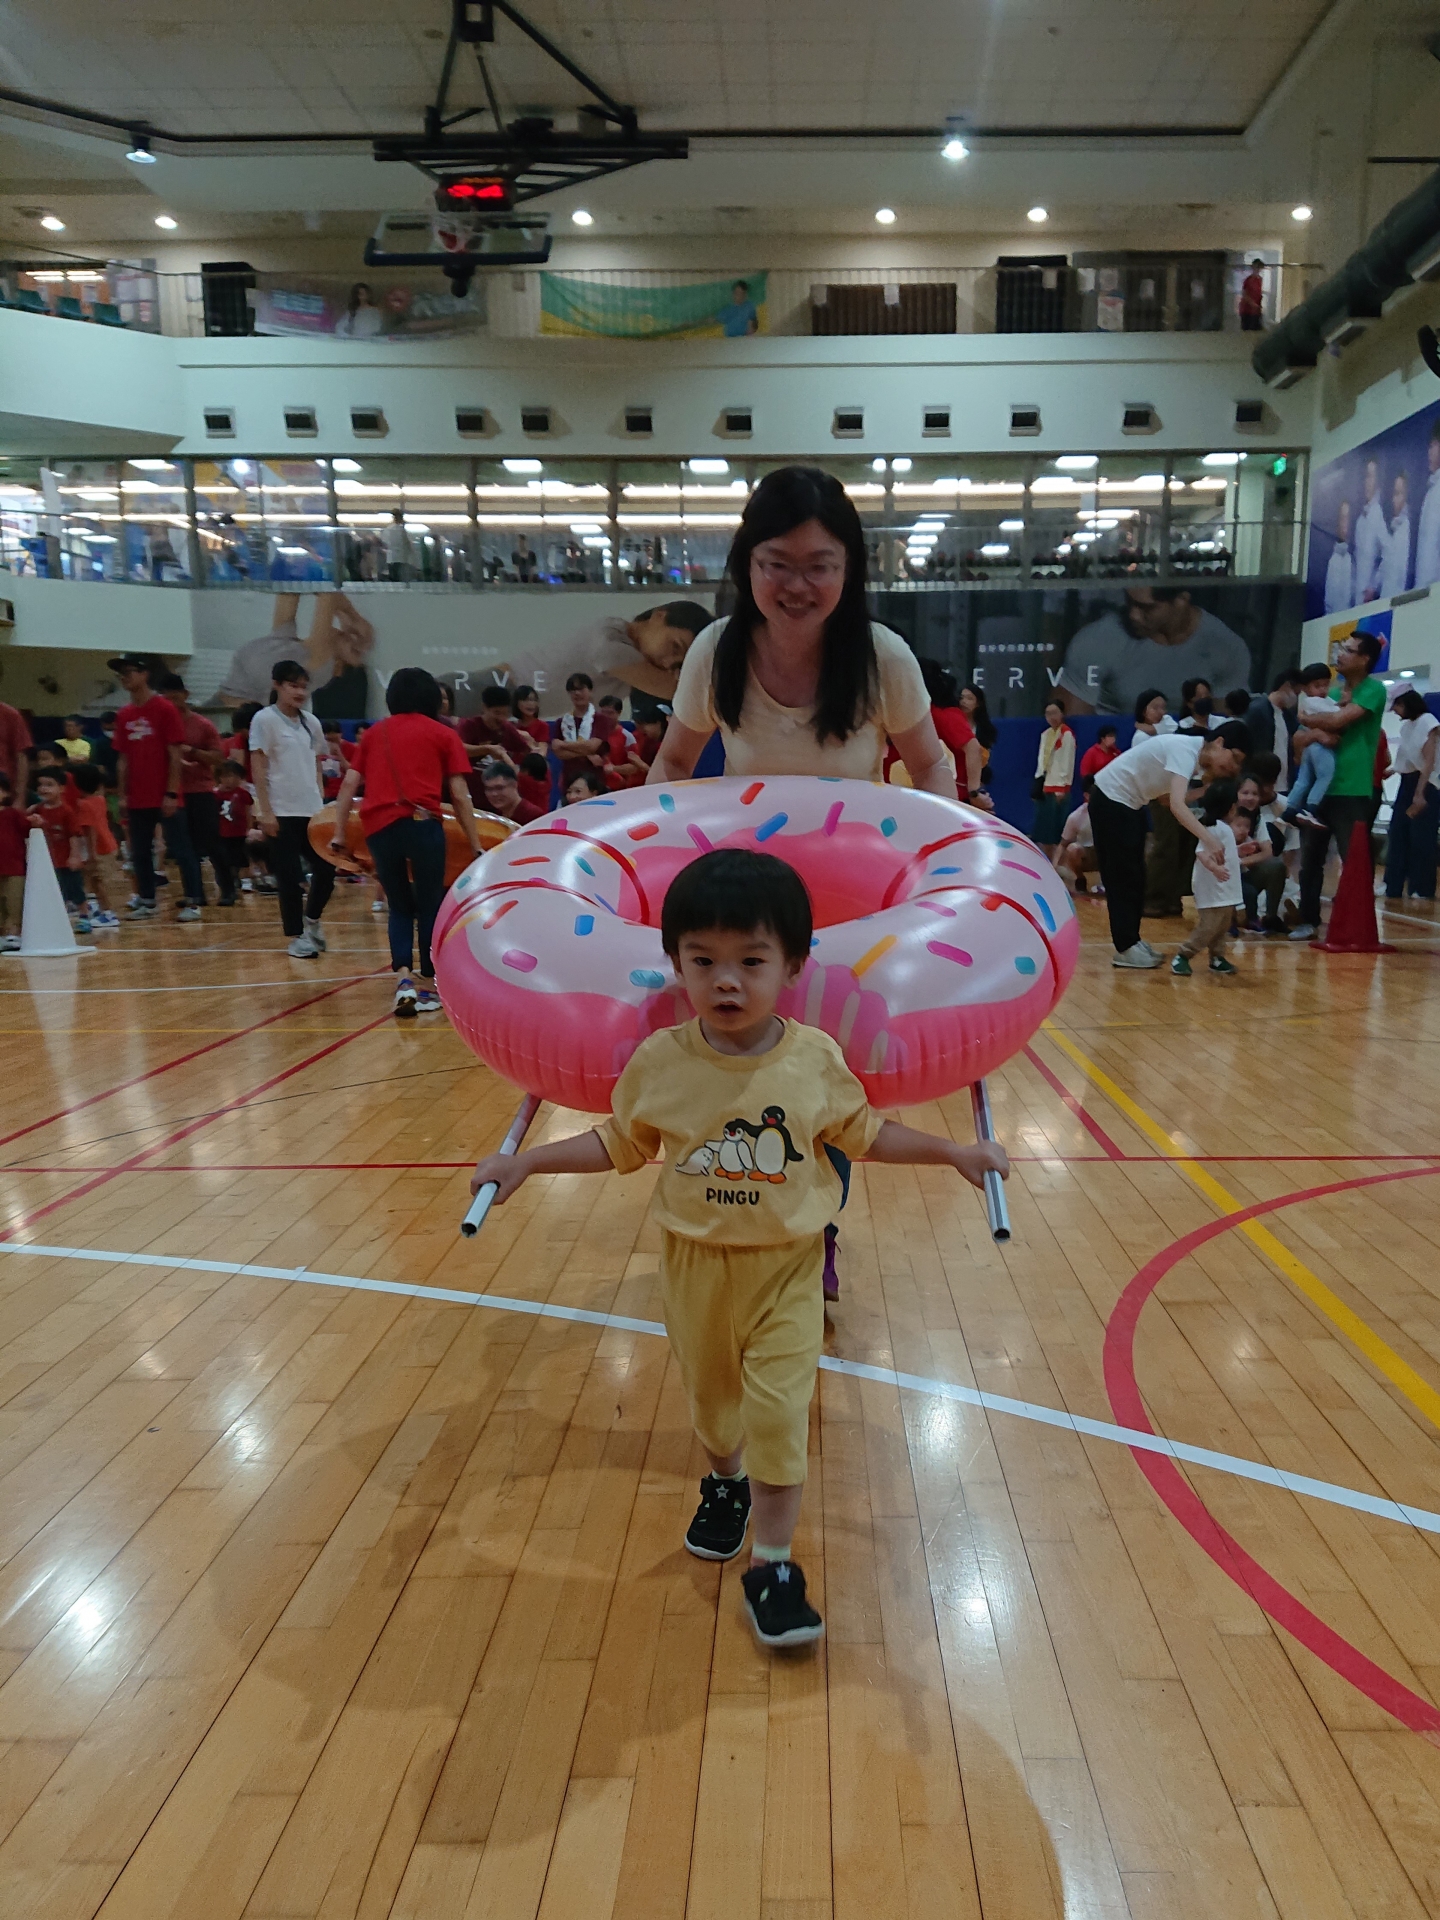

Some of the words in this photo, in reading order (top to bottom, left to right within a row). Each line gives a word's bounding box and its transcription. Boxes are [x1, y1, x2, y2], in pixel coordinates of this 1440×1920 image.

[375, 669, 547, 692] VRVE
[941, 665, 1100, 689] ERVE
[705, 1187, 760, 1206] PINGU
